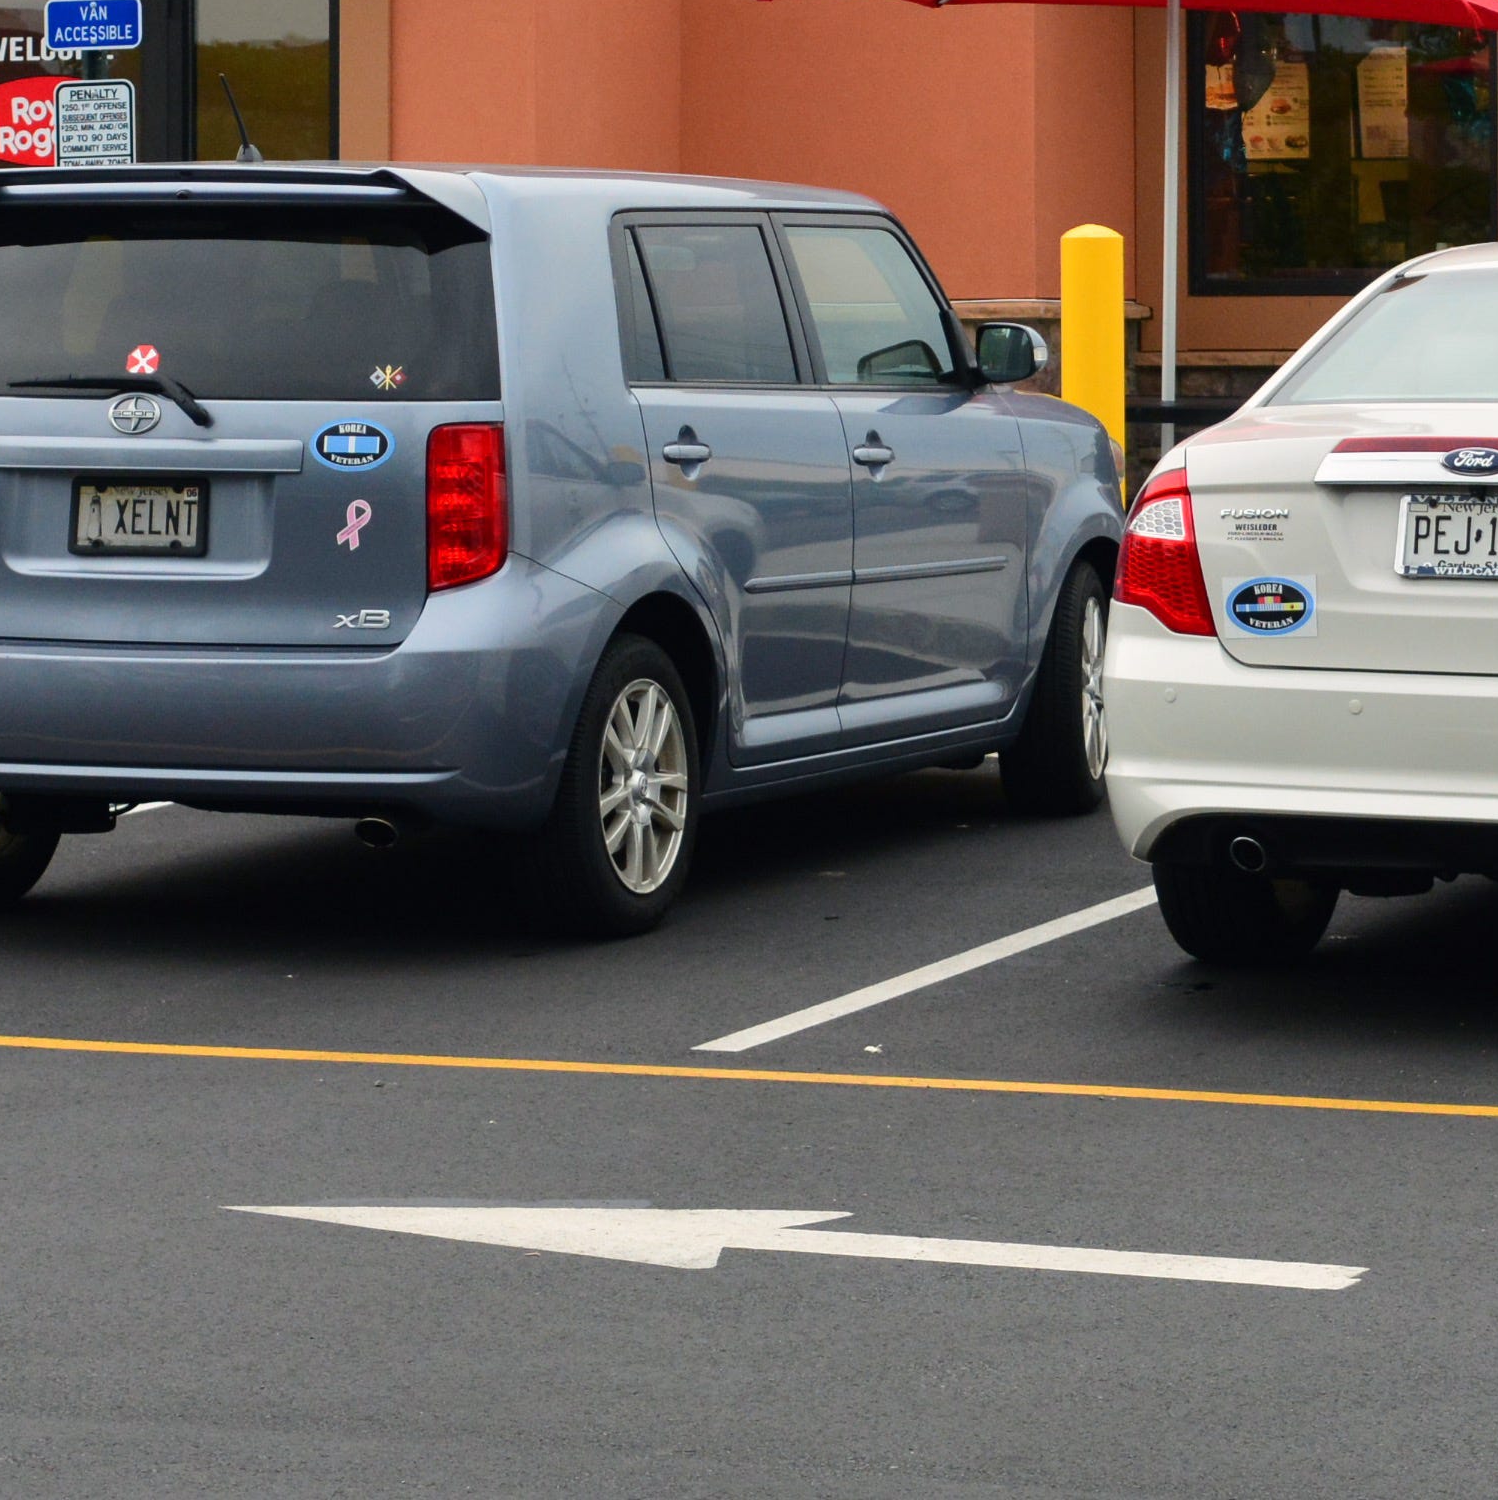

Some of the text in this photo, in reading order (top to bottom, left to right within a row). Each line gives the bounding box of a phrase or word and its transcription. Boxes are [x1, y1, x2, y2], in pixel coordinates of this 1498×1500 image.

[79, 5, 108, 21] VAN
[54, 24, 133, 43] ACCESSIBLE
[70, 88, 119, 100] PENALTY
[93, 102, 127, 111] OFFENSE
[99, 111, 128, 120] OFFENSES
[62, 132, 128, 143] UP TO 90 DAYS
[62, 143, 128, 153] COMMUNITY SERVICE
[338, 423, 367, 435] KOREA
[330, 453, 375, 465] VETERAN
[1453, 450, 1495, 468] Ford
[1220, 508, 1290, 520] FUSION
[1441, 503, 1476, 514] New
[114, 499, 199, 536] XELNT
[1235, 523, 1278, 531] WEISLEDER
[1253, 583, 1283, 595] KOREA
[332, 609, 390, 629] xB
[1248, 616, 1294, 629] VETERAN
